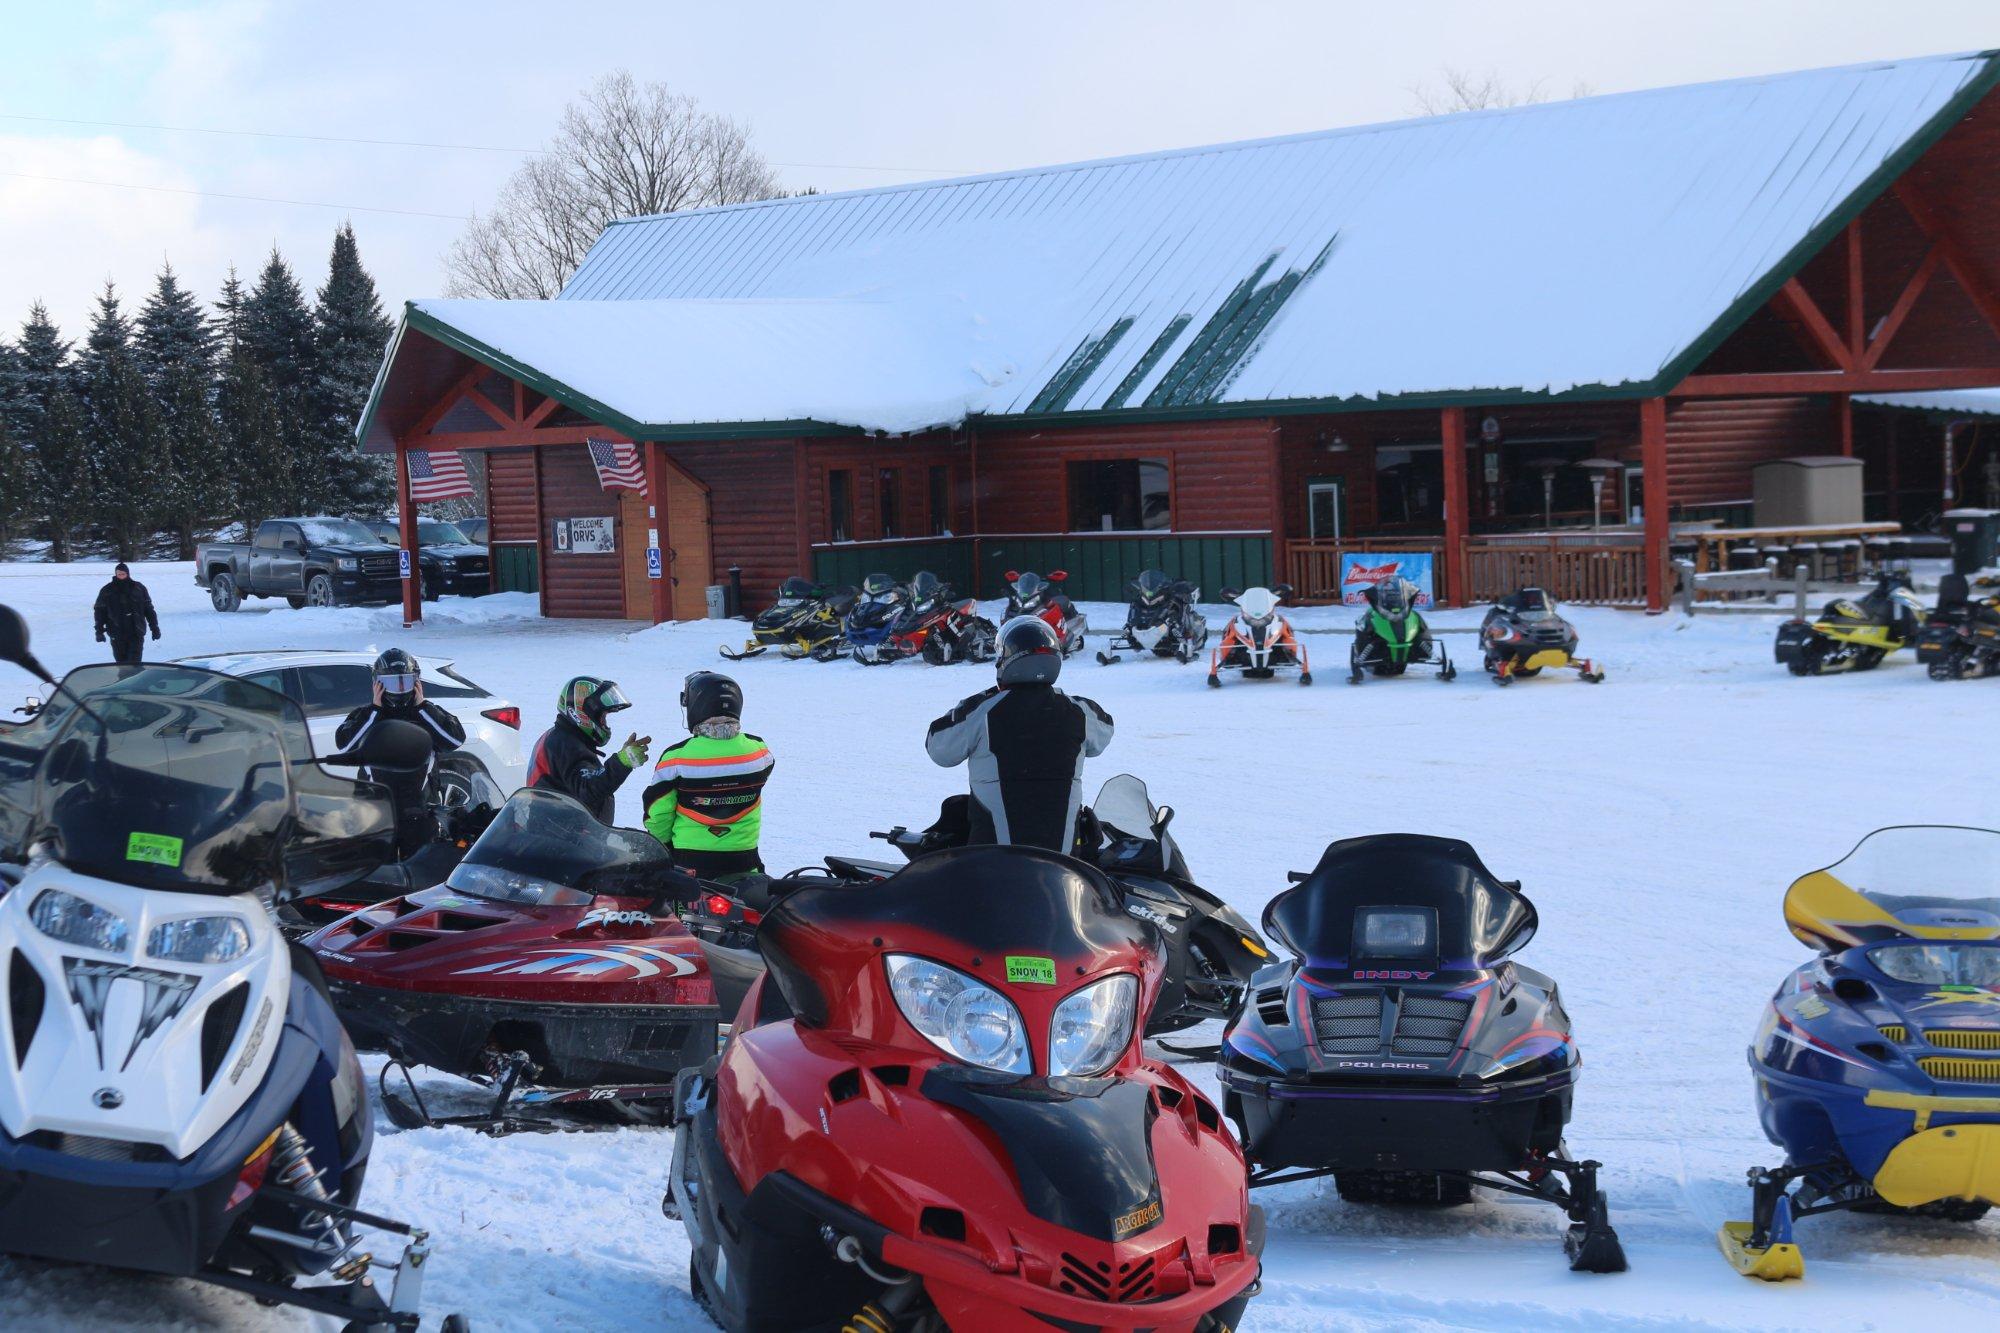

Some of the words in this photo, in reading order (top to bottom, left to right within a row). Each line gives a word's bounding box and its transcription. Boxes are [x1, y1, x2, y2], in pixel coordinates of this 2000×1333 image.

[573, 531, 596, 542] ORVS
[1009, 967, 1039, 978] SNOW
[1042, 969, 1053, 979] 18
[1353, 970, 1435, 980] INDY
[1339, 1061, 1431, 1070] POLARIS
[1114, 1207, 1149, 1235] ARCTIC
[1147, 1201, 1161, 1222] CAT
